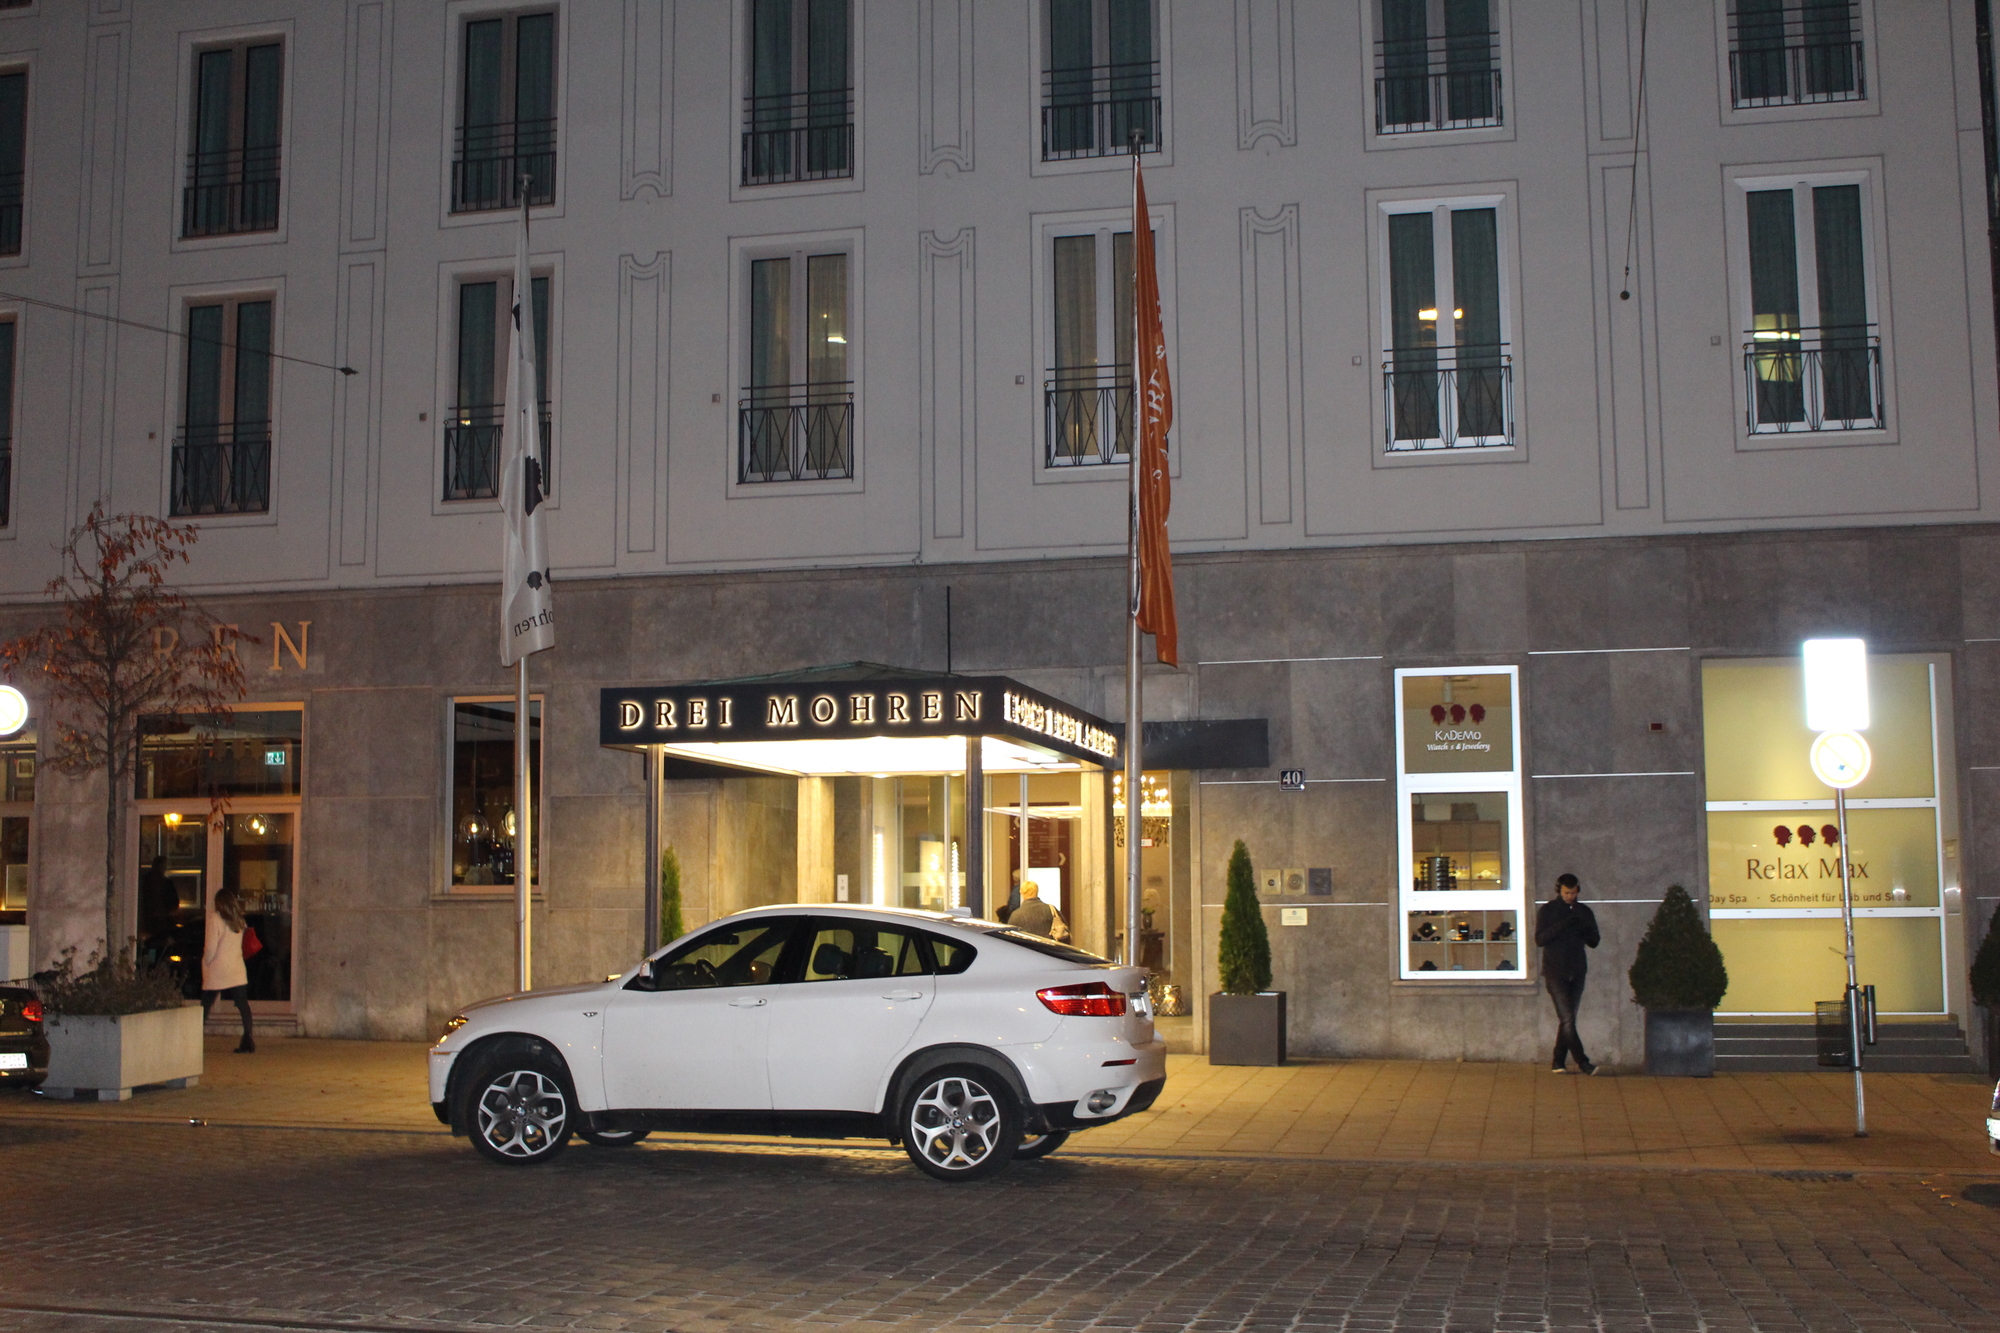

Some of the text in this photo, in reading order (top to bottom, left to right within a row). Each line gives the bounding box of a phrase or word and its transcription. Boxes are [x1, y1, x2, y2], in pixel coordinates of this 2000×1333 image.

[620, 698, 732, 729] DREI
[766, 691, 981, 726] MOHREN
[1282, 771, 1301, 785] 40
[1747, 857, 1869, 879] Relax Max
[1729, 893, 1747, 904] Spa
[1770, 893, 1818, 903] Schönheit
[1821, 893, 1836, 902] für
[1863, 892, 1882, 902] und
